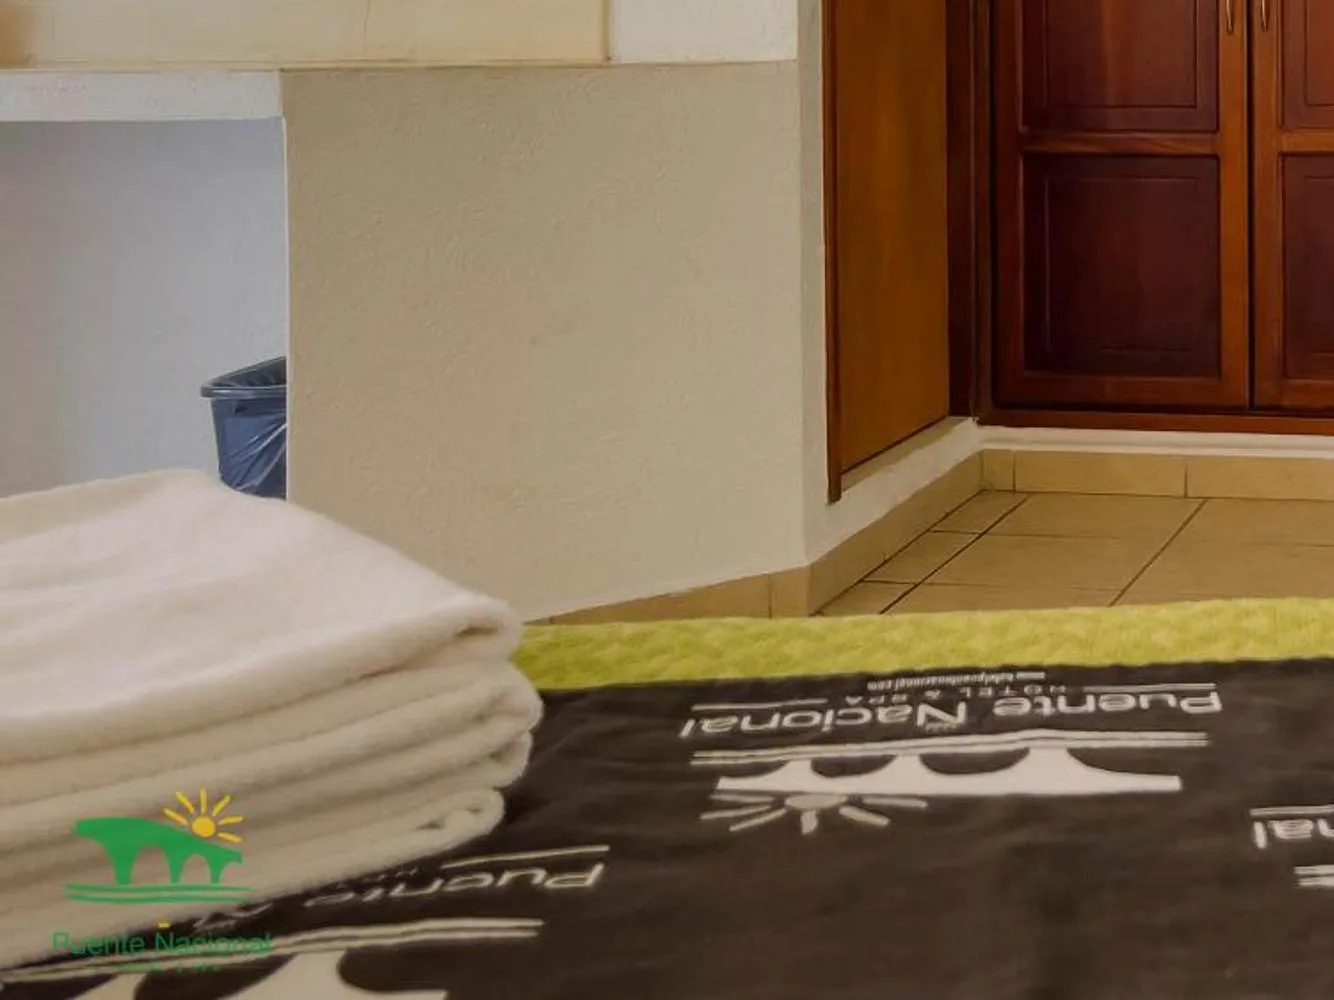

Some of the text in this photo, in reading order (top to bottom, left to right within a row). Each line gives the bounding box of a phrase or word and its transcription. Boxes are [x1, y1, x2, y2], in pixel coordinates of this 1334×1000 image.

[959, 684, 1067, 699] HOTEL
[678, 691, 1223, 738] Puente Nacional
